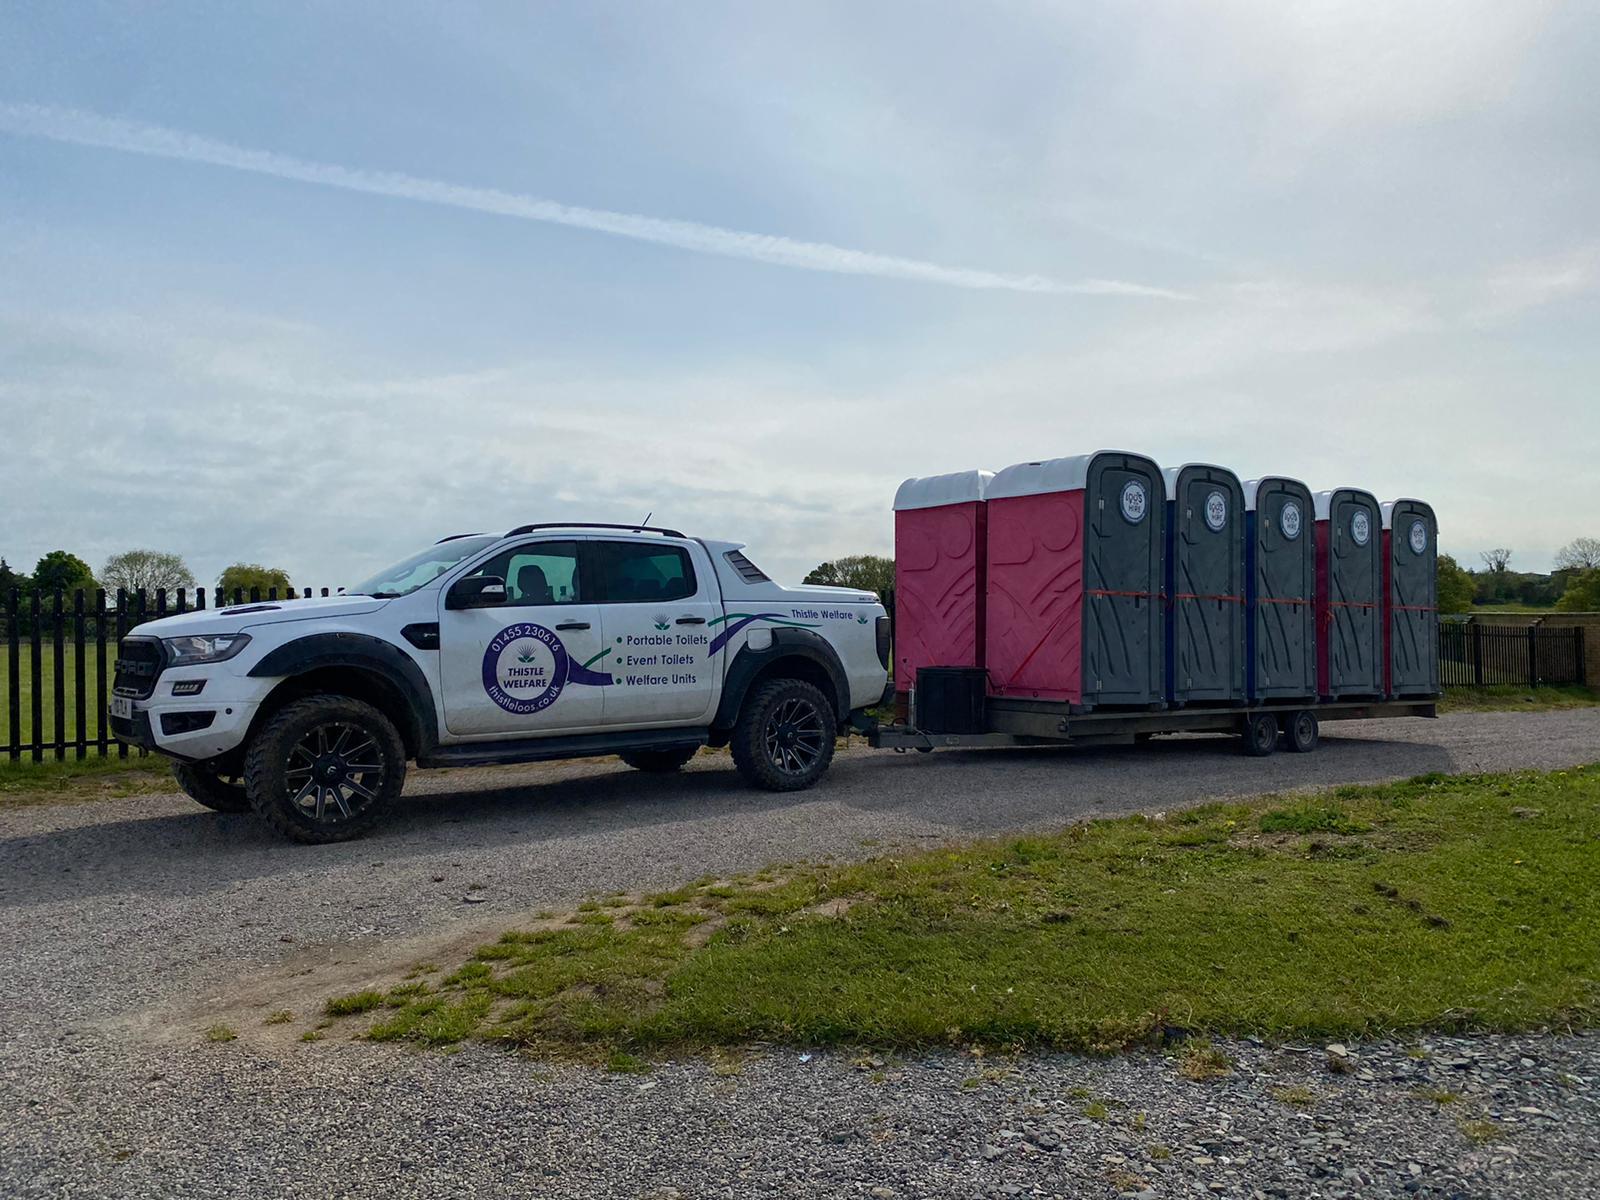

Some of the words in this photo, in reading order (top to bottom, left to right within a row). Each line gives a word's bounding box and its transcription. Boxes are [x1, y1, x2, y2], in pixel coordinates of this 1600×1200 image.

[791, 609, 819, 619] Thistle
[821, 610, 853, 620] Welfare
[491, 626, 522, 652] 01455
[525, 625, 561, 652] 230616
[626, 635, 673, 646] Portable
[675, 634, 708, 645] Toilets
[626, 655, 657, 666] Event
[661, 654, 694, 665] Toilets
[508, 667, 544, 677] THISTLE
[503, 679, 547, 688] WELFARE
[625, 675, 668, 686] Welfare
[672, 673, 697, 684] Units
[488, 684, 560, 712] thistleloos.co.uk
